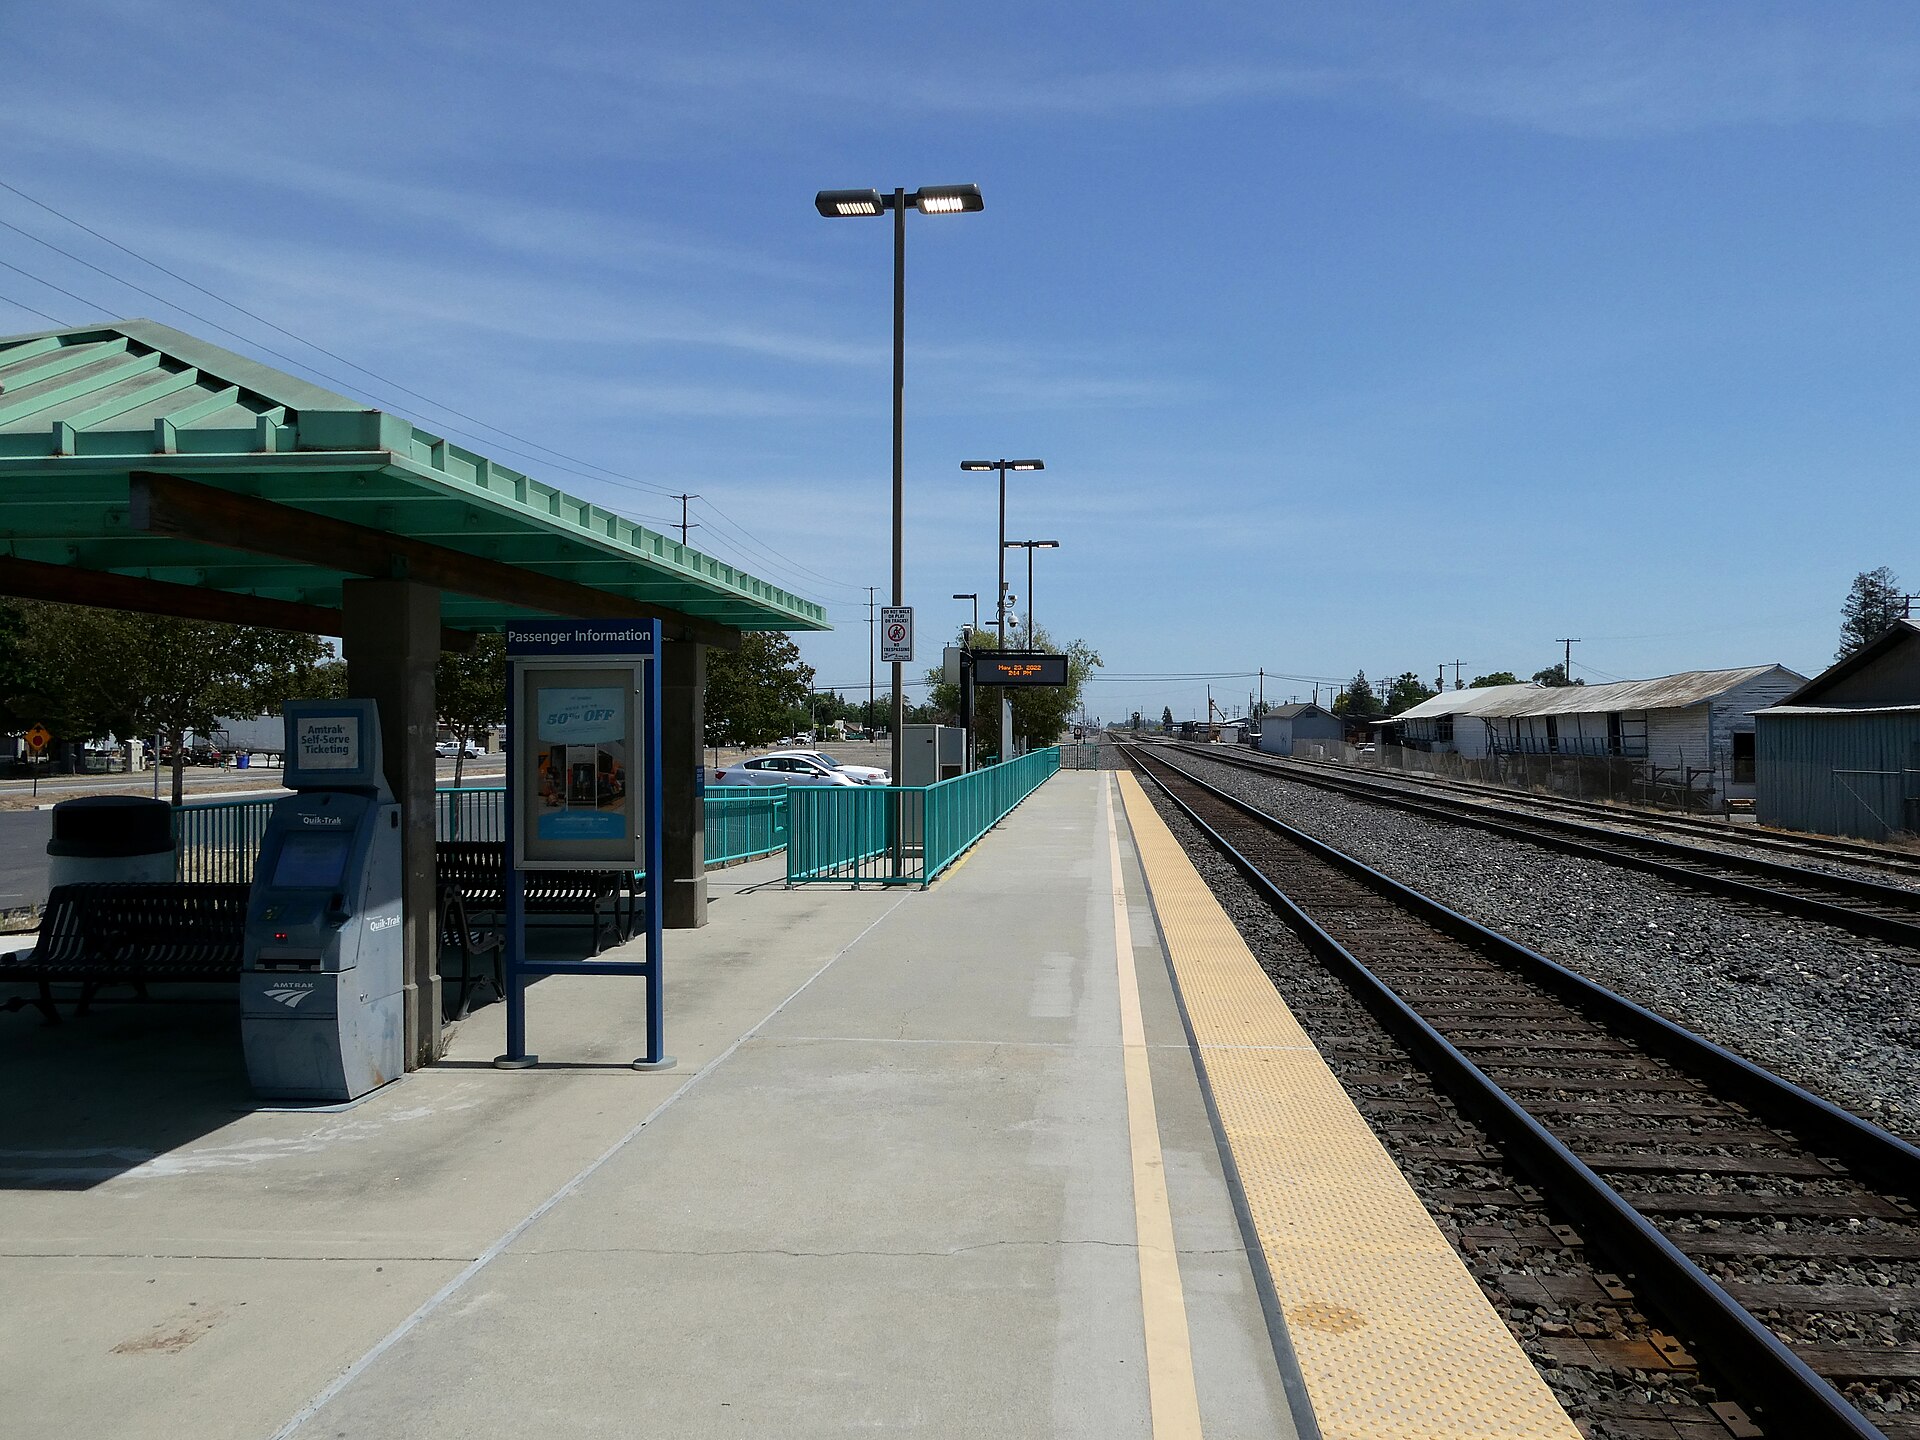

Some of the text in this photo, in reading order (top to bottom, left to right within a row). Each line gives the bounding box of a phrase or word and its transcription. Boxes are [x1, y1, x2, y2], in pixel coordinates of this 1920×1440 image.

[508, 629, 651, 645] Passenger Information
[547, 709, 615, 725] 50% OFF
[301, 735, 350, 744] Self-Serve
[305, 744, 349, 755] Ticketing
[303, 816, 342, 825] Quik-Trak
[370, 915, 401, 931] Quik-Trak
